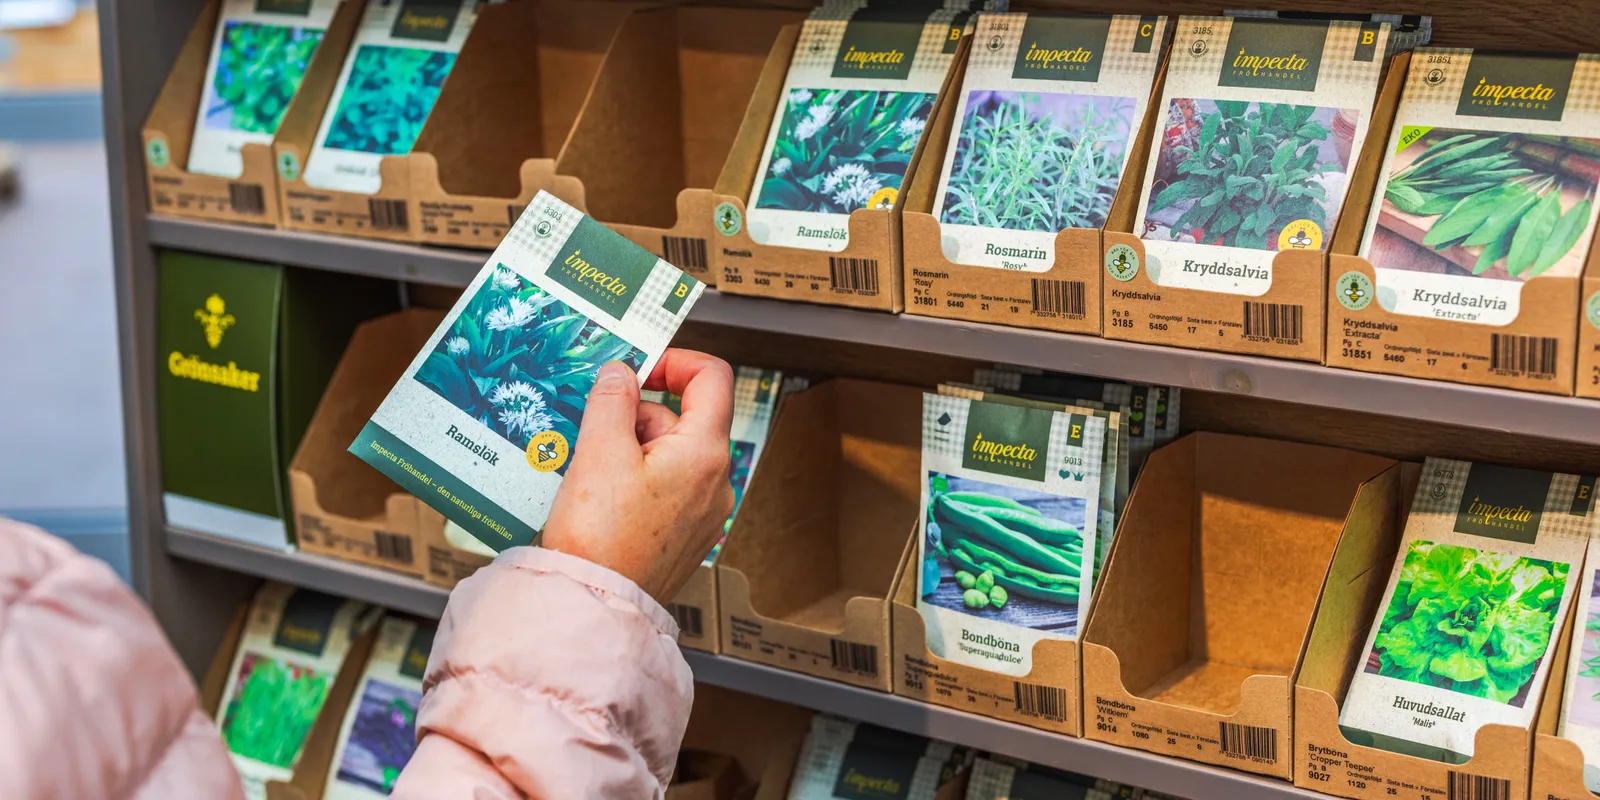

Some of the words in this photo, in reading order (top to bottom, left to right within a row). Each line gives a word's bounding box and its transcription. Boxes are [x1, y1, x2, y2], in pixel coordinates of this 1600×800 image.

[949, 28, 960, 41] B
[1140, 24, 1152, 38] C
[1361, 30, 1375, 46] B
[843, 46, 905, 69] impecta
[1025, 41, 1093, 69] impecta
[1233, 47, 1309, 77] impecta
[1471, 75, 1556, 106] impecta
[1402, 128, 1421, 145] EKO
[796, 226, 847, 240] Ramslök
[984, 243, 1047, 260] Rosmarin
[564, 249, 627, 296] impecta
[913, 268, 949, 279] Rosmarin
[1182, 259, 1268, 280] Kryddsalvia
[674, 282, 689, 298] B
[1112, 289, 1161, 301] Kryddsalvia
[914, 295, 937, 306] 31801
[947, 299, 964, 308] 5440
[1412, 288, 1507, 310] Kryddsalvia
[981, 303, 989, 311] 21
[1112, 309, 1121, 317] Pg
[1112, 318, 1133, 328] 3185
[1149, 322, 1168, 331] 5450
[1343, 318, 1398, 332] Kryddsalvia
[1342, 339, 1352, 347] Pg
[1342, 348, 1371, 359] 31851
[1384, 353, 1405, 363] 5460
[1426, 358, 1437, 366] 17
[1461, 362, 1468, 370] 6
[1070, 424, 1082, 439] E
[445, 424, 500, 467] Ramslök
[972, 432, 1037, 462] impecta
[1064, 456, 1082, 466] 9013
[370, 440, 397, 463] Impecta
[397, 457, 433, 486] Fröhandel
[437, 485, 451, 499] den
[450, 495, 482, 519] naturliga
[481, 514, 513, 541] frökällan
[1578, 485, 1591, 499] E
[1468, 495, 1533, 525] impecta
[961, 628, 1020, 653] Bondböna
[1392, 695, 1466, 723] Huvudsallat
[1096, 714, 1105, 723] Pg
[1097, 722, 1117, 734] 9014
[1131, 730, 1149, 740] 1080
[1308, 753, 1342, 767] 'Cropper
[1344, 760, 1375, 773] Teepee'
[1308, 762, 1317, 771] Pg
[1308, 770, 1331, 782] 9027
[1347, 779, 1366, 789] 1120
[1387, 787, 1397, 795] 25
